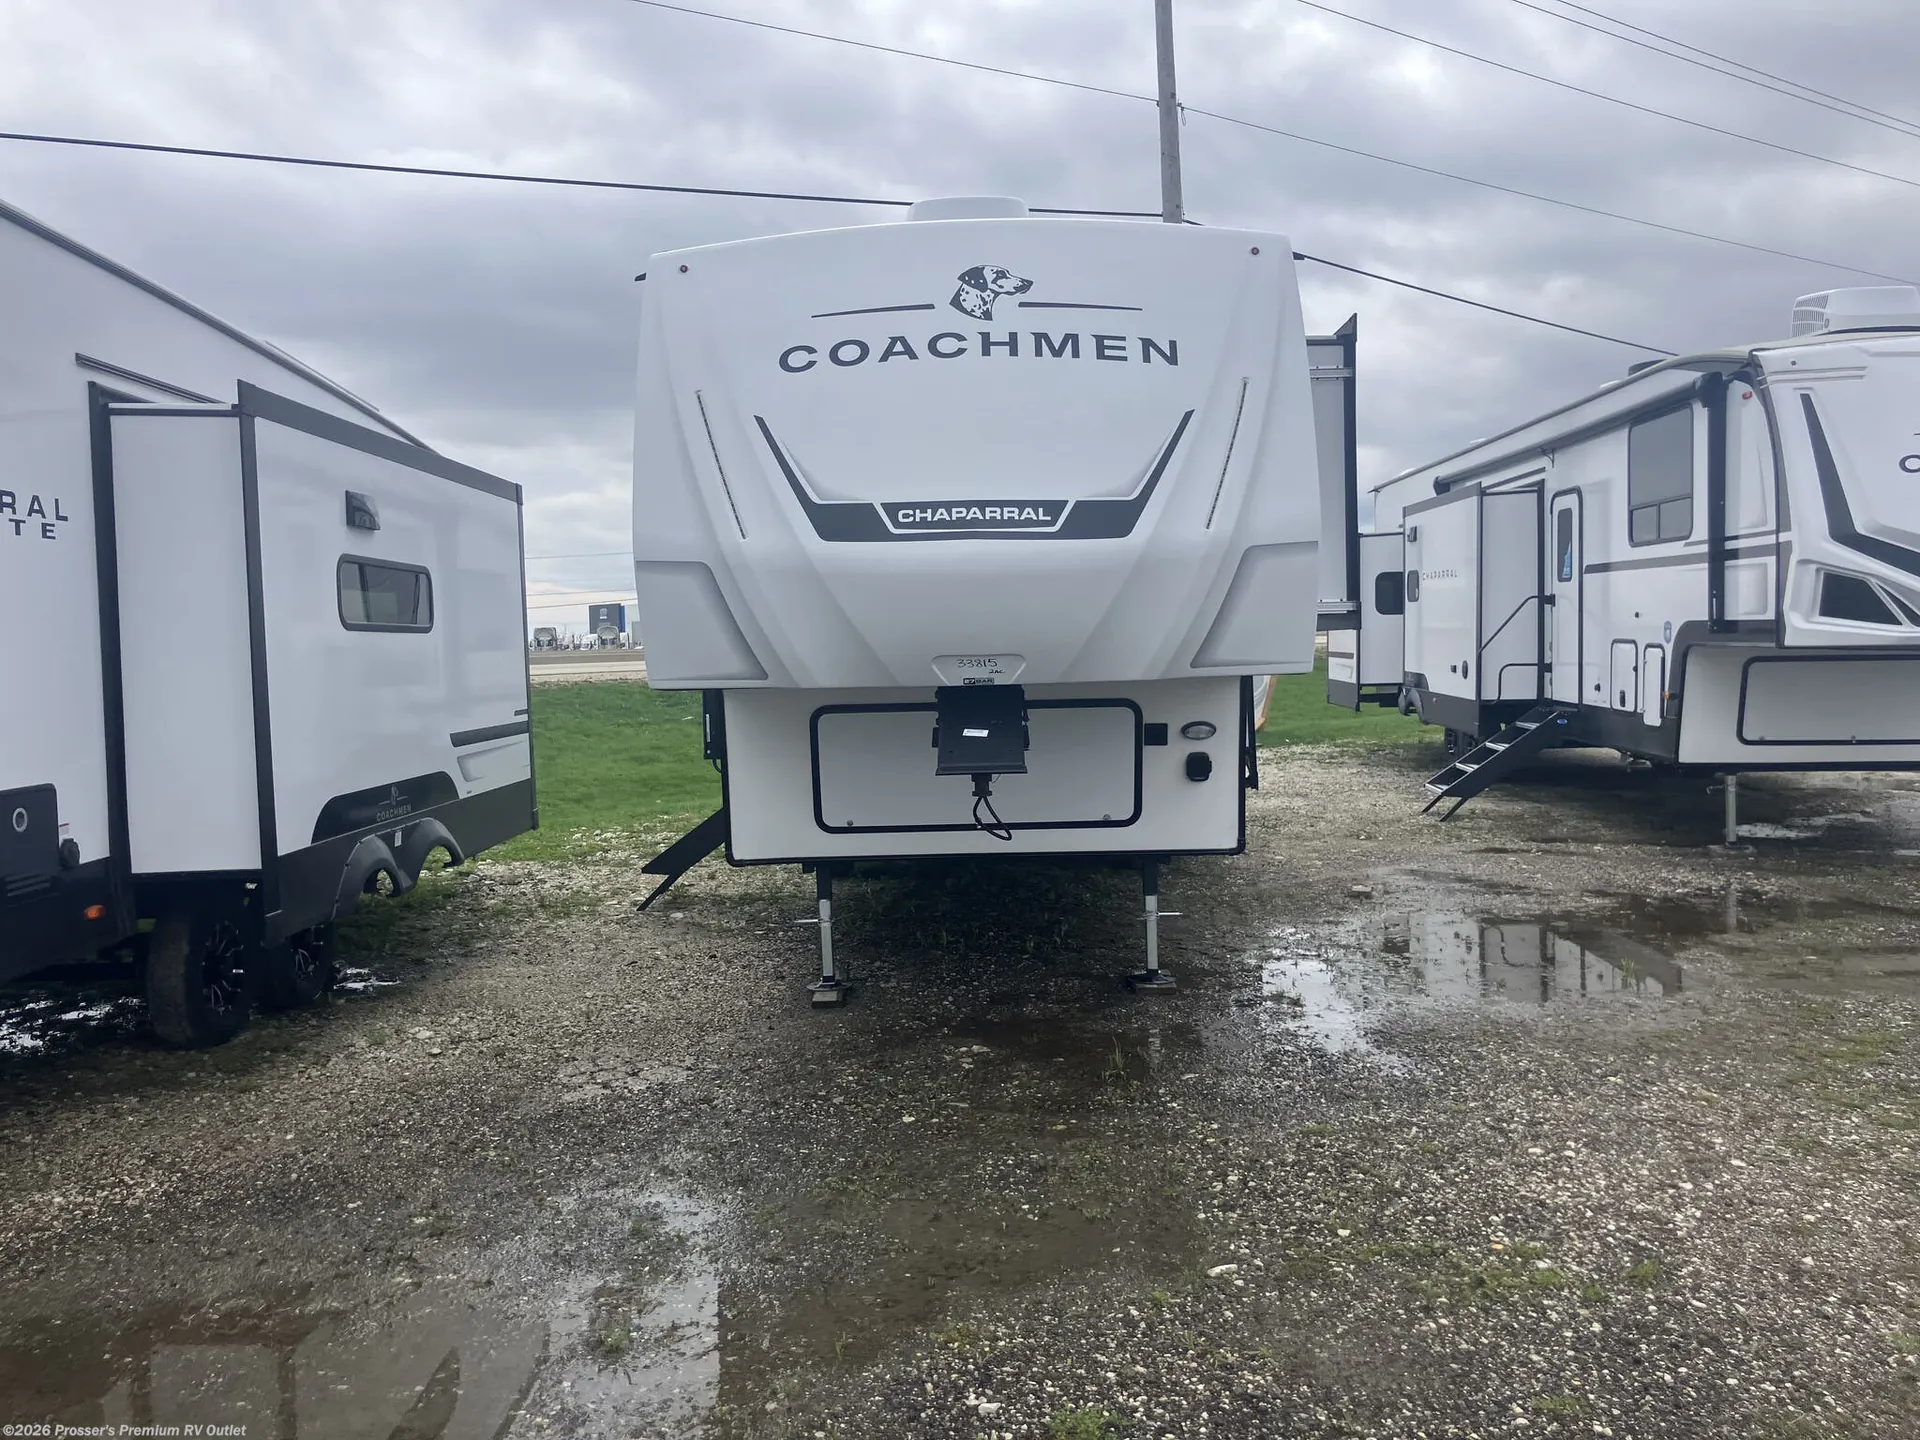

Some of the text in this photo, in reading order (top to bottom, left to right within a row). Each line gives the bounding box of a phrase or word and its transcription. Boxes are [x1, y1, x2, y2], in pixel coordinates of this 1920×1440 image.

[778, 331, 1179, 373] COACHMEN
[897, 506, 1052, 523] CHAPARRAL
[957, 658, 998, 668] 33815
[376, 803, 412, 822] COACHMEN
